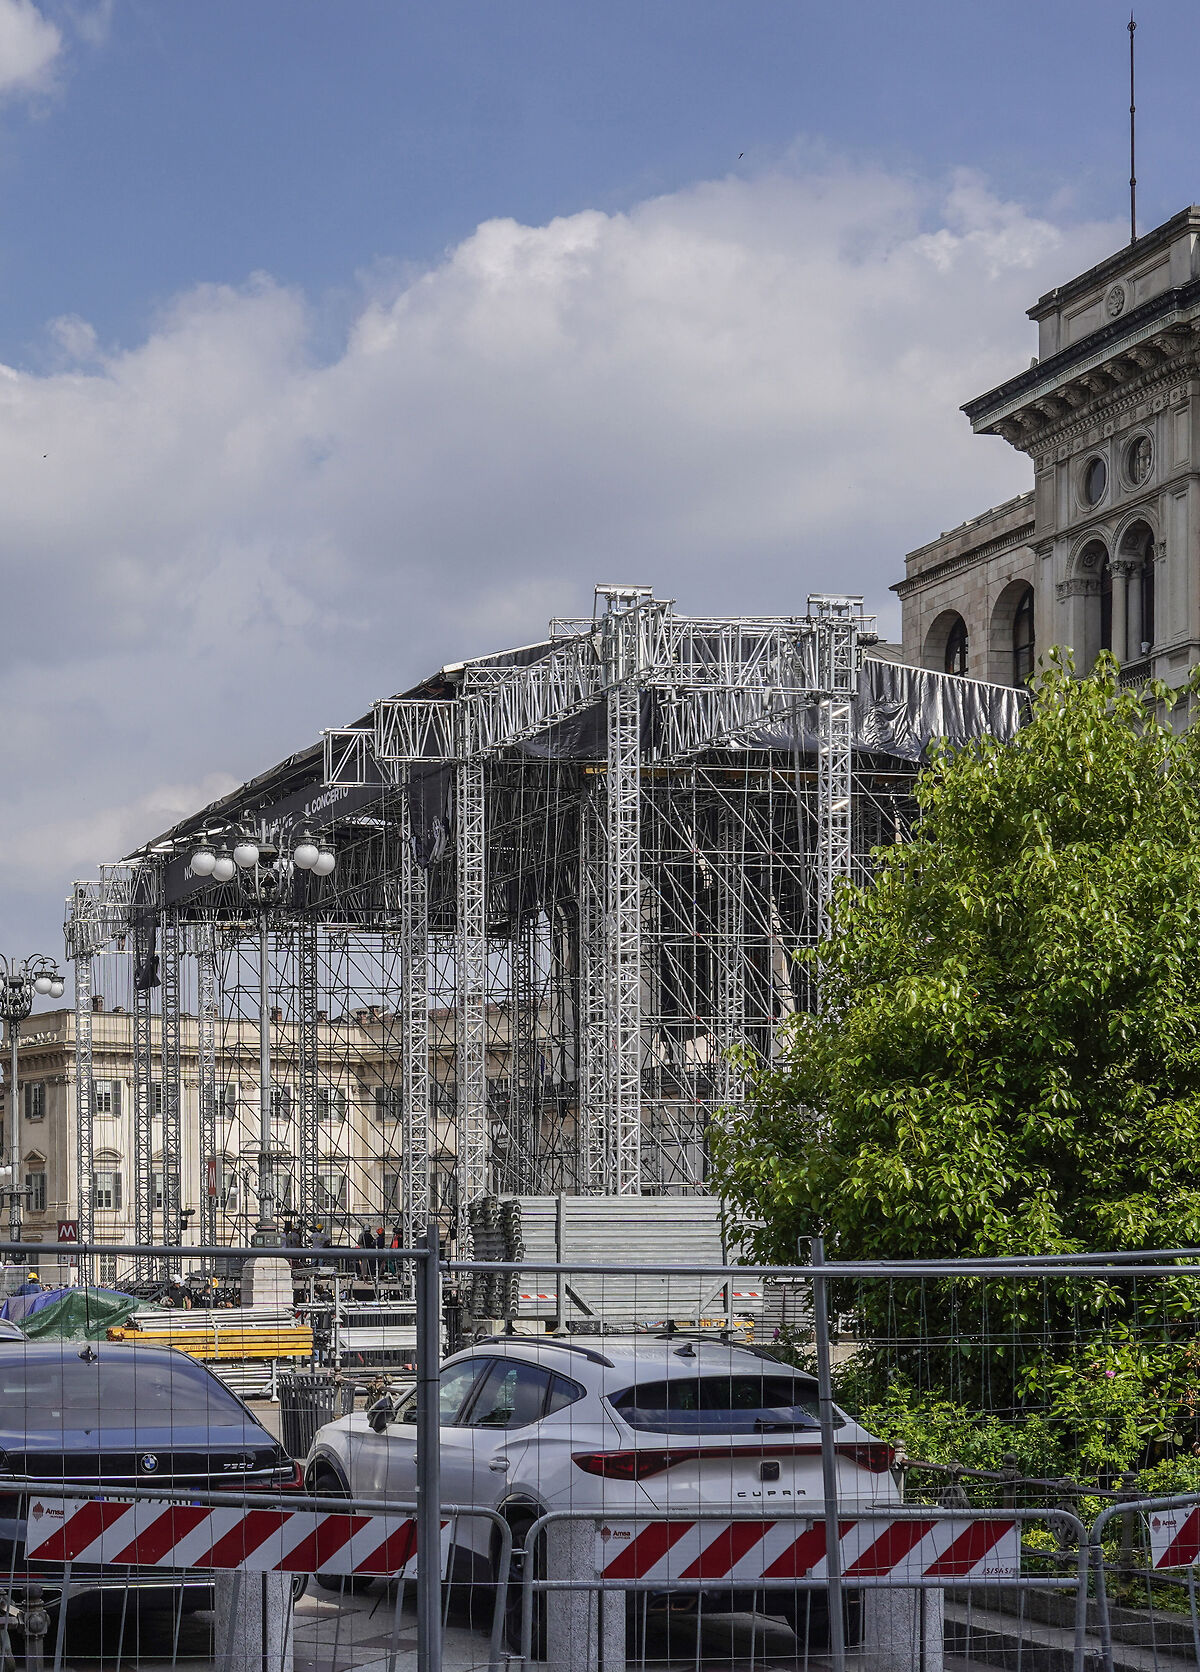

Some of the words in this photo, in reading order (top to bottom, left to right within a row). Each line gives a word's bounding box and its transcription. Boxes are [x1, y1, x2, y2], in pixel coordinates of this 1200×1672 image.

[311, 787, 349, 814] CONCERTO
[60, 1224, 76, 1238] M
[737, 1489, 807, 1498] CUPRA
